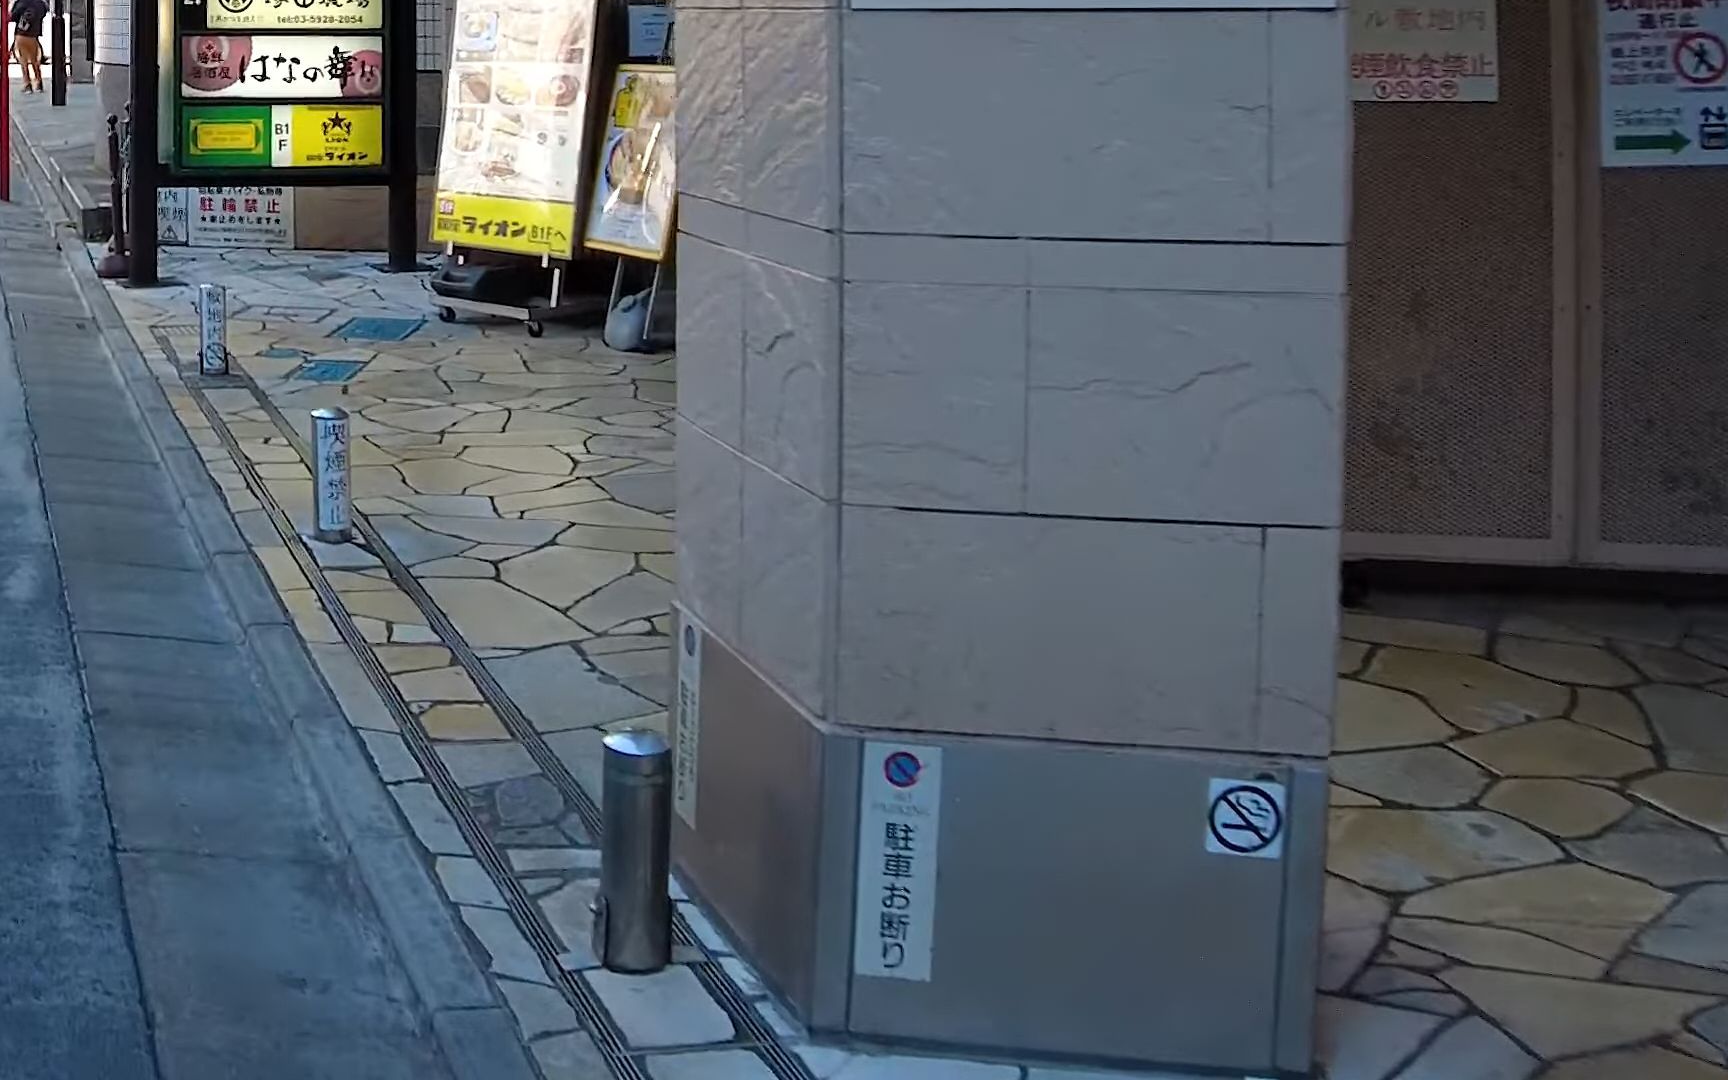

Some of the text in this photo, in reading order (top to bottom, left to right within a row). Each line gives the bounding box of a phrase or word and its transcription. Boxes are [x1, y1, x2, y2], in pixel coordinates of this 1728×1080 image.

[325, 152, 369, 162] ライオン
[199, 196, 281, 214] 駐輪禁止
[462, 215, 527, 238] ライオン
[879, 821, 917, 968] 駐車お断り
